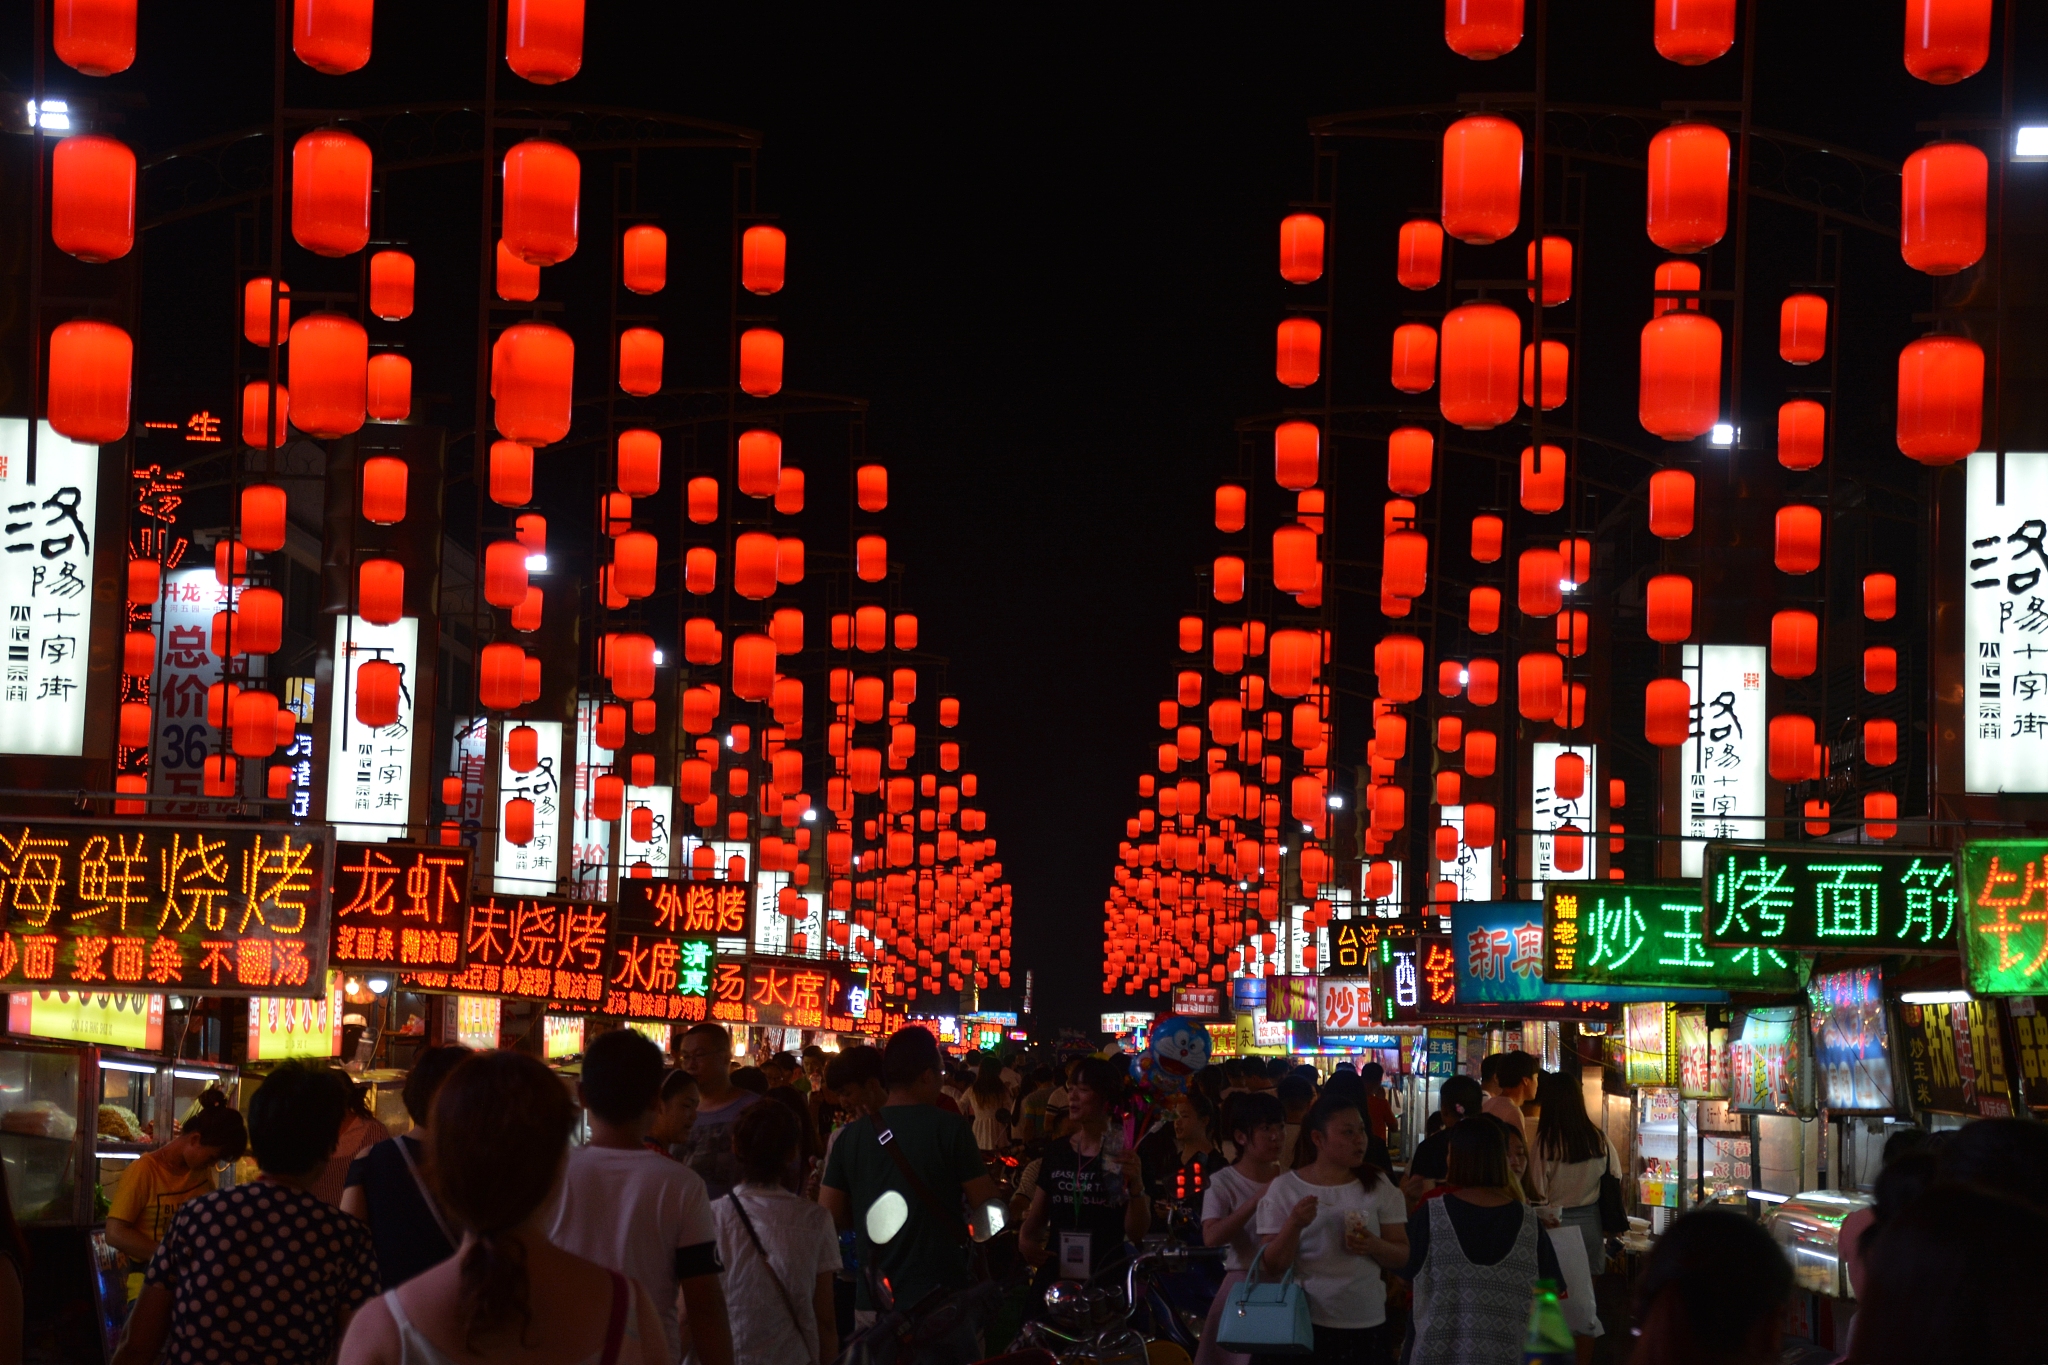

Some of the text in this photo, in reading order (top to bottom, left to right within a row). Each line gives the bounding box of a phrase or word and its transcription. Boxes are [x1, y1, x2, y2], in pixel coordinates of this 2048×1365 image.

[0, 827, 313, 933] 海鲜烧烤
[338, 849, 464, 924] 龙虾
[1716, 856, 1958, 942] 烤面筋
[71, 934, 183, 983] 浆面条
[200, 938, 309, 987] 不翻汤
[611, 936, 681, 992] 水席
[678, 941, 713, 997] 清真
[752, 968, 825, 1010] 水席
[1429, 1041, 1454, 1055] 生蚝
[1911, 1038, 1932, 1105] 炒玉米
